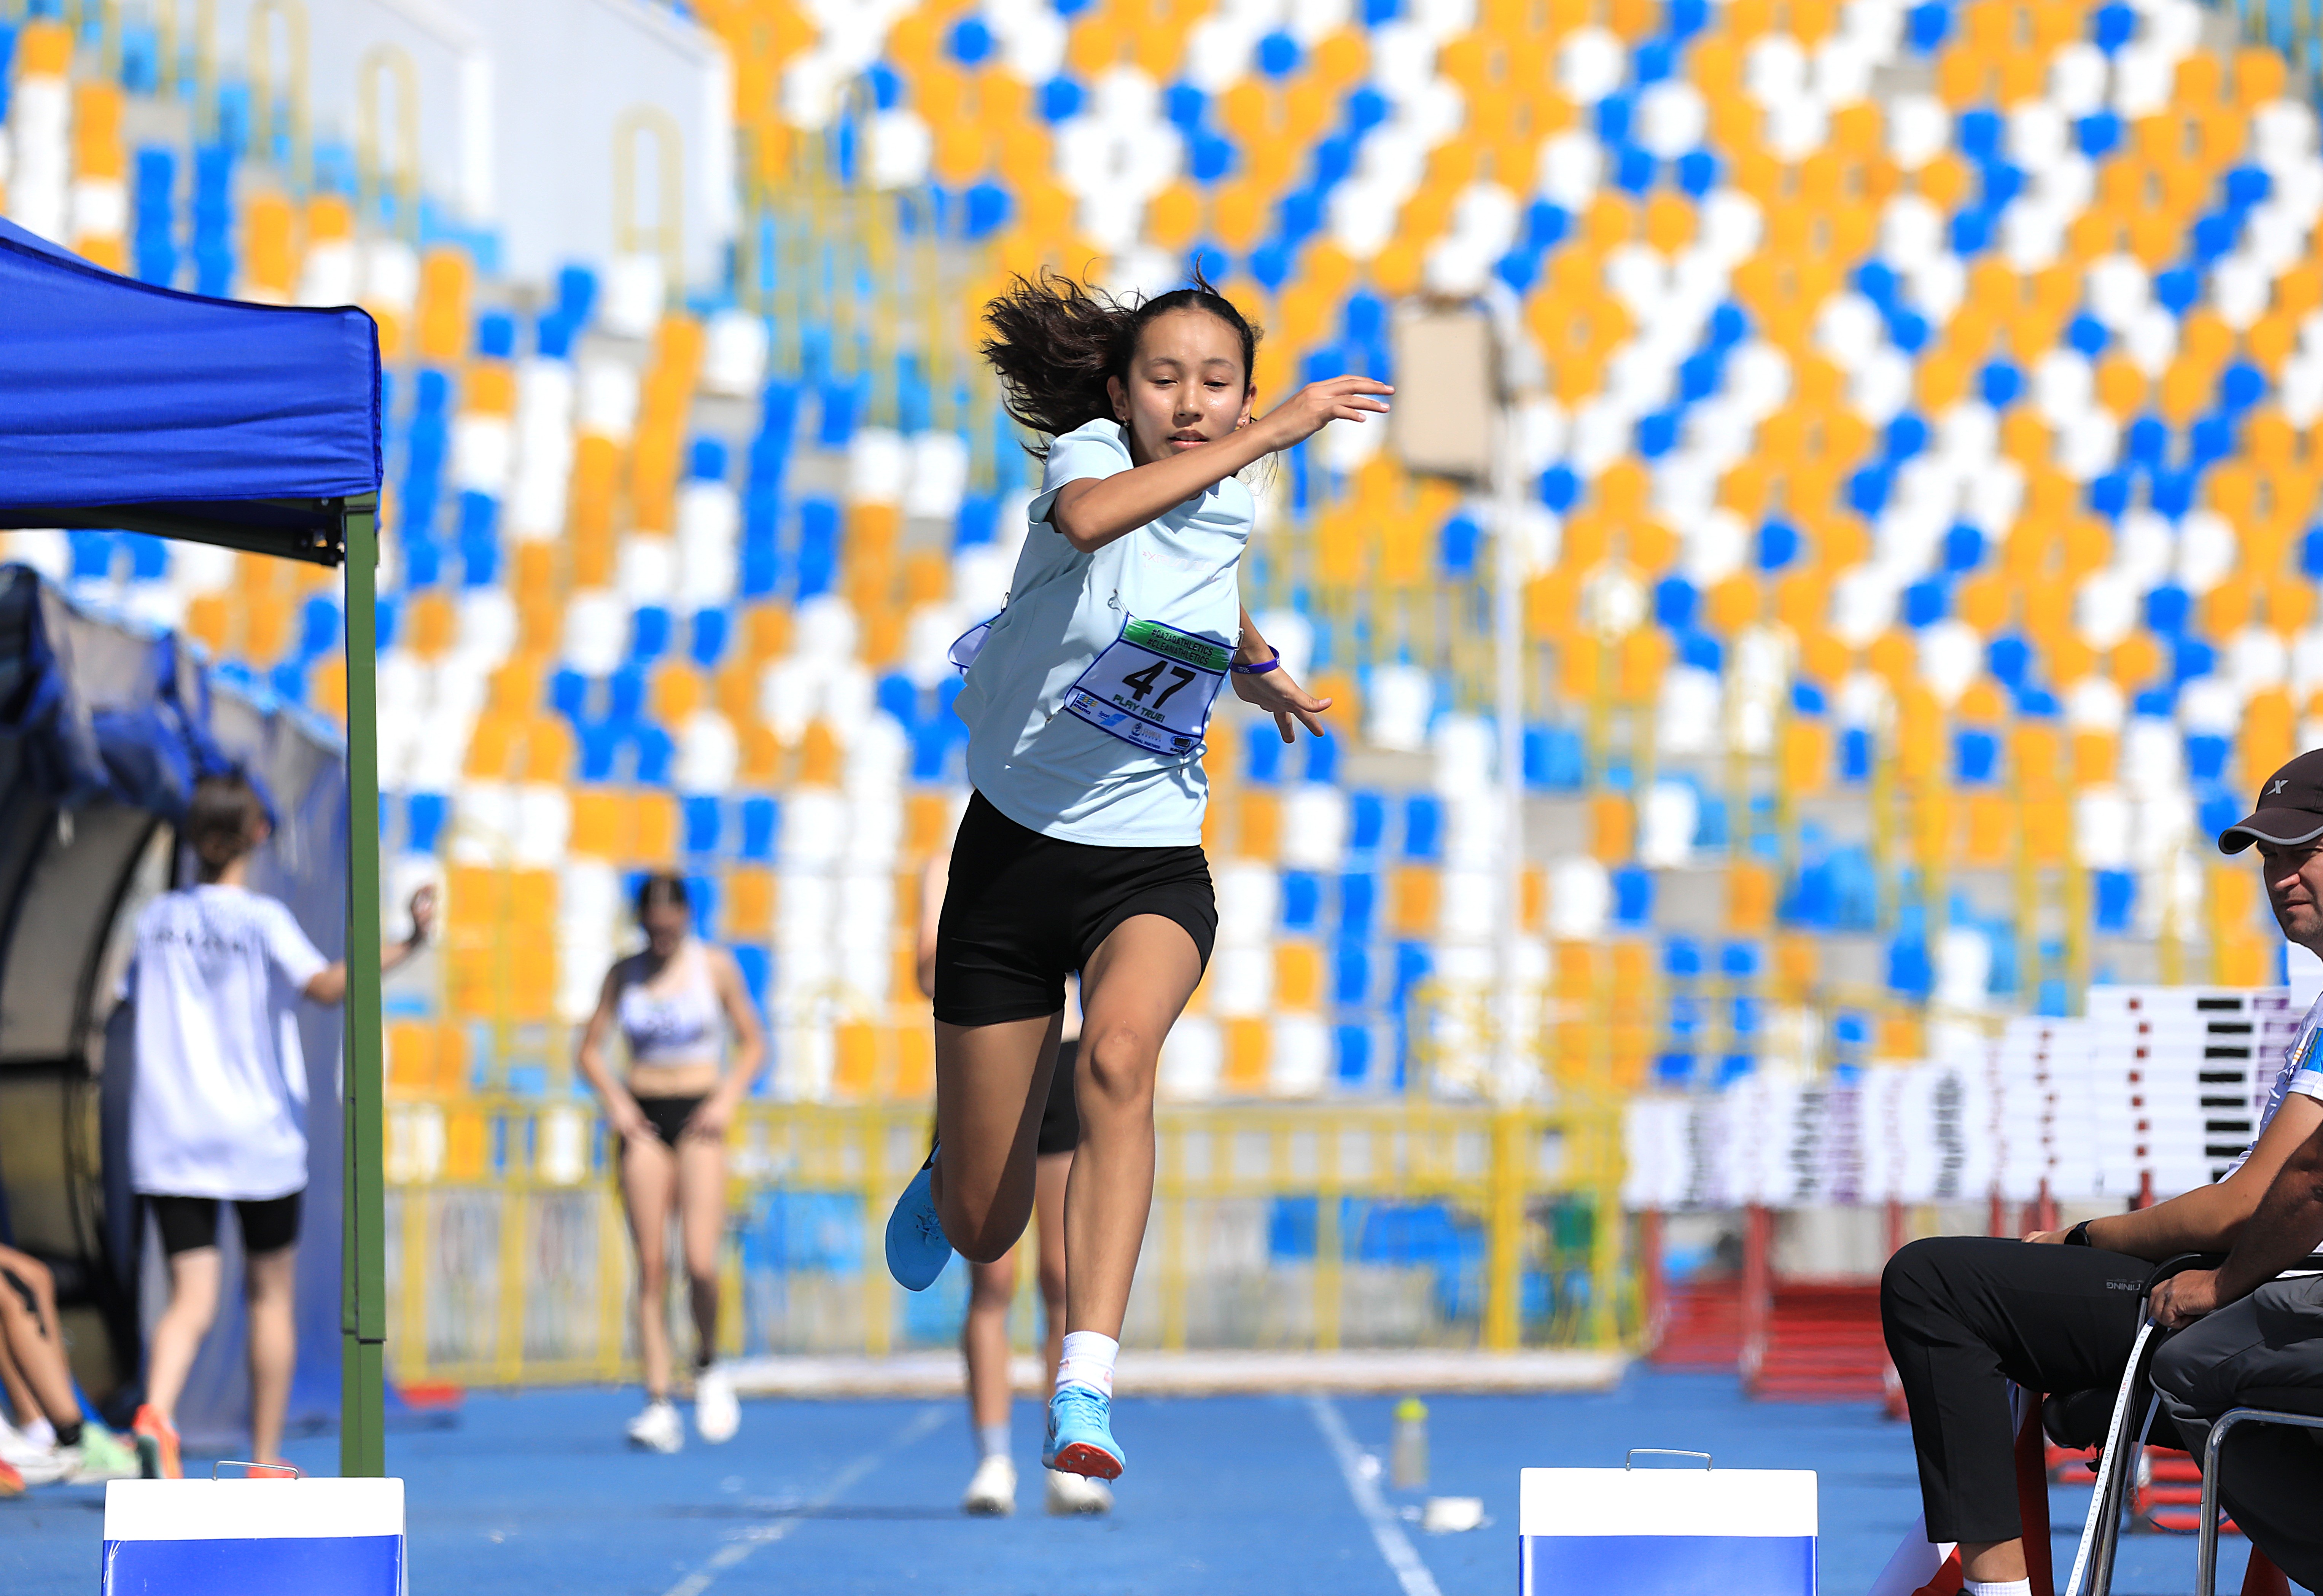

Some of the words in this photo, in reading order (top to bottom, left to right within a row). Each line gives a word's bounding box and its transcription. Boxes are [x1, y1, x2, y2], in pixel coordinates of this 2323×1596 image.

[1146, 638, 1209, 665] #CLEANATHLETICS
[1150, 628, 1214, 656] #QAZAQATHLETICS
[1122, 660, 1197, 710] 47
[1074, 703, 1091, 715] ATHLETICS
[1113, 694, 1140, 711] PLAY
[1141, 707, 1165, 723] TRUE!
[1128, 735, 1144, 744] GENERAL
